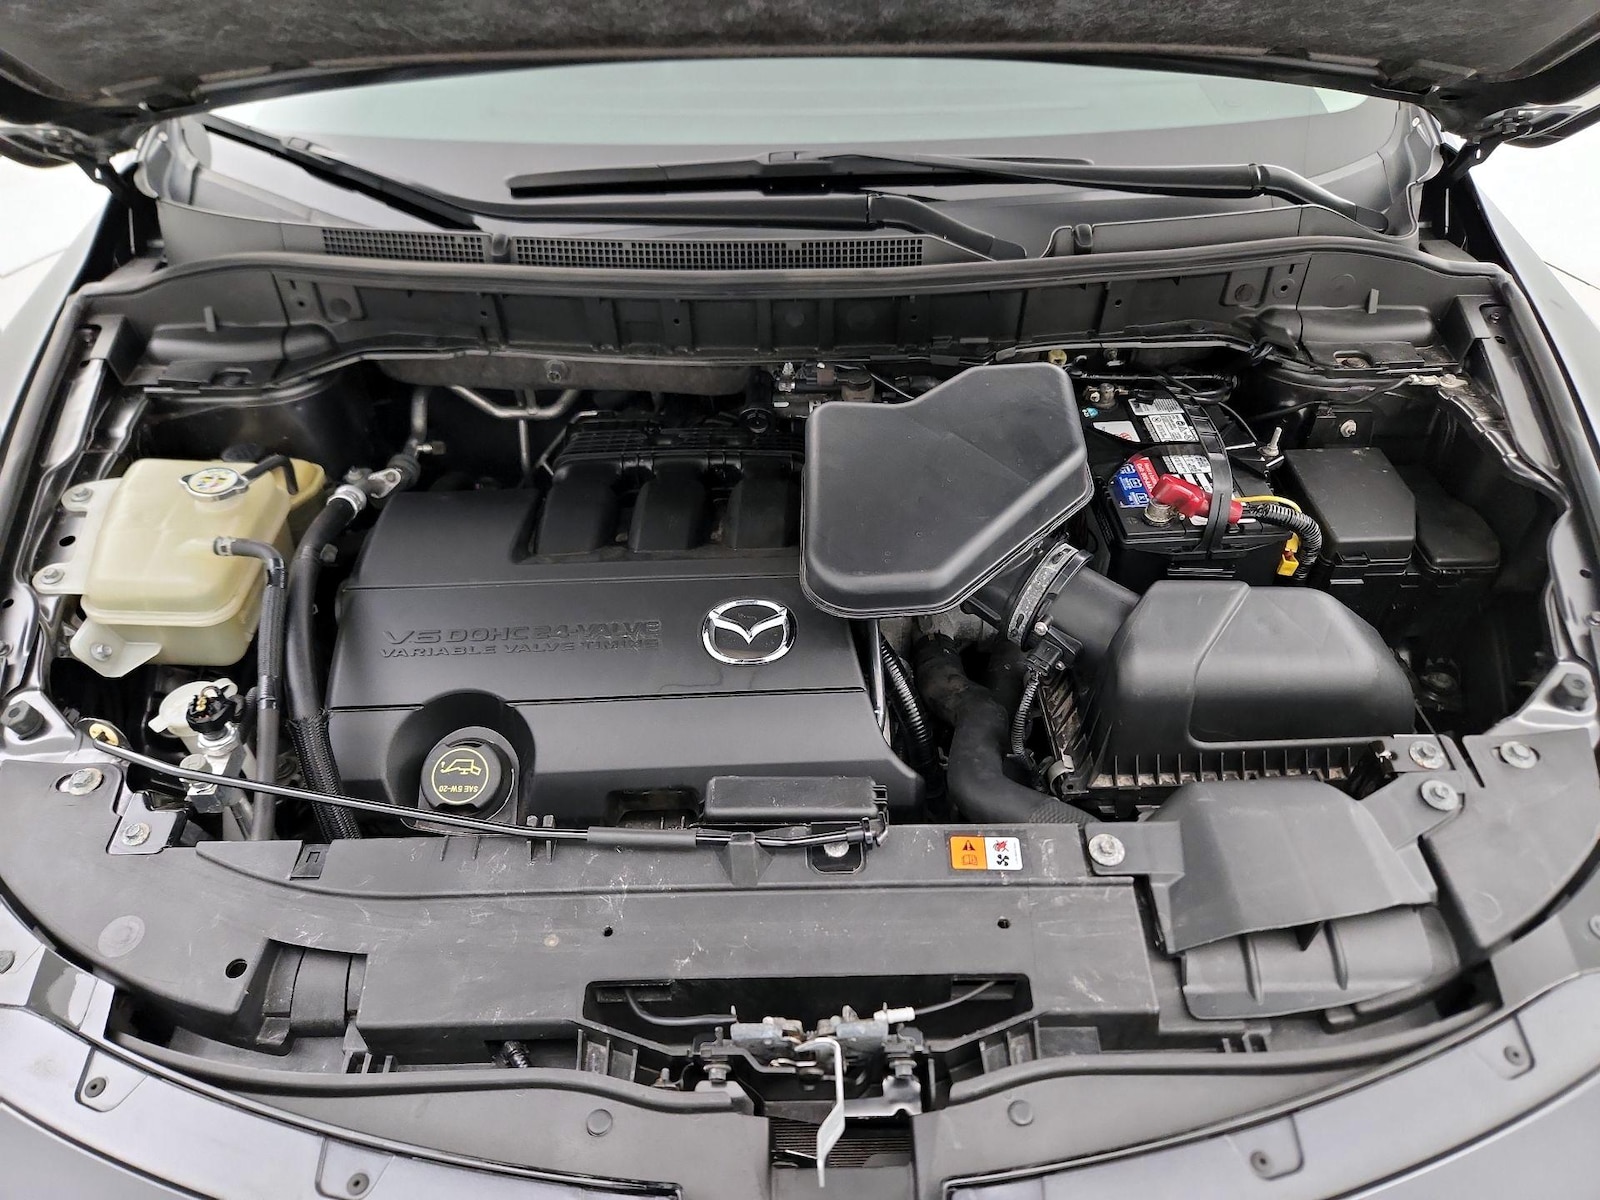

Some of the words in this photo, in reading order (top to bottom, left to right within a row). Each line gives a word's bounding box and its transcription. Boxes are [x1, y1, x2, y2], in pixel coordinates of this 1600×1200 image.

[445, 626, 530, 643] DOHC
[381, 645, 497, 658] VARIABLE
[504, 642, 576, 654] VALVE
